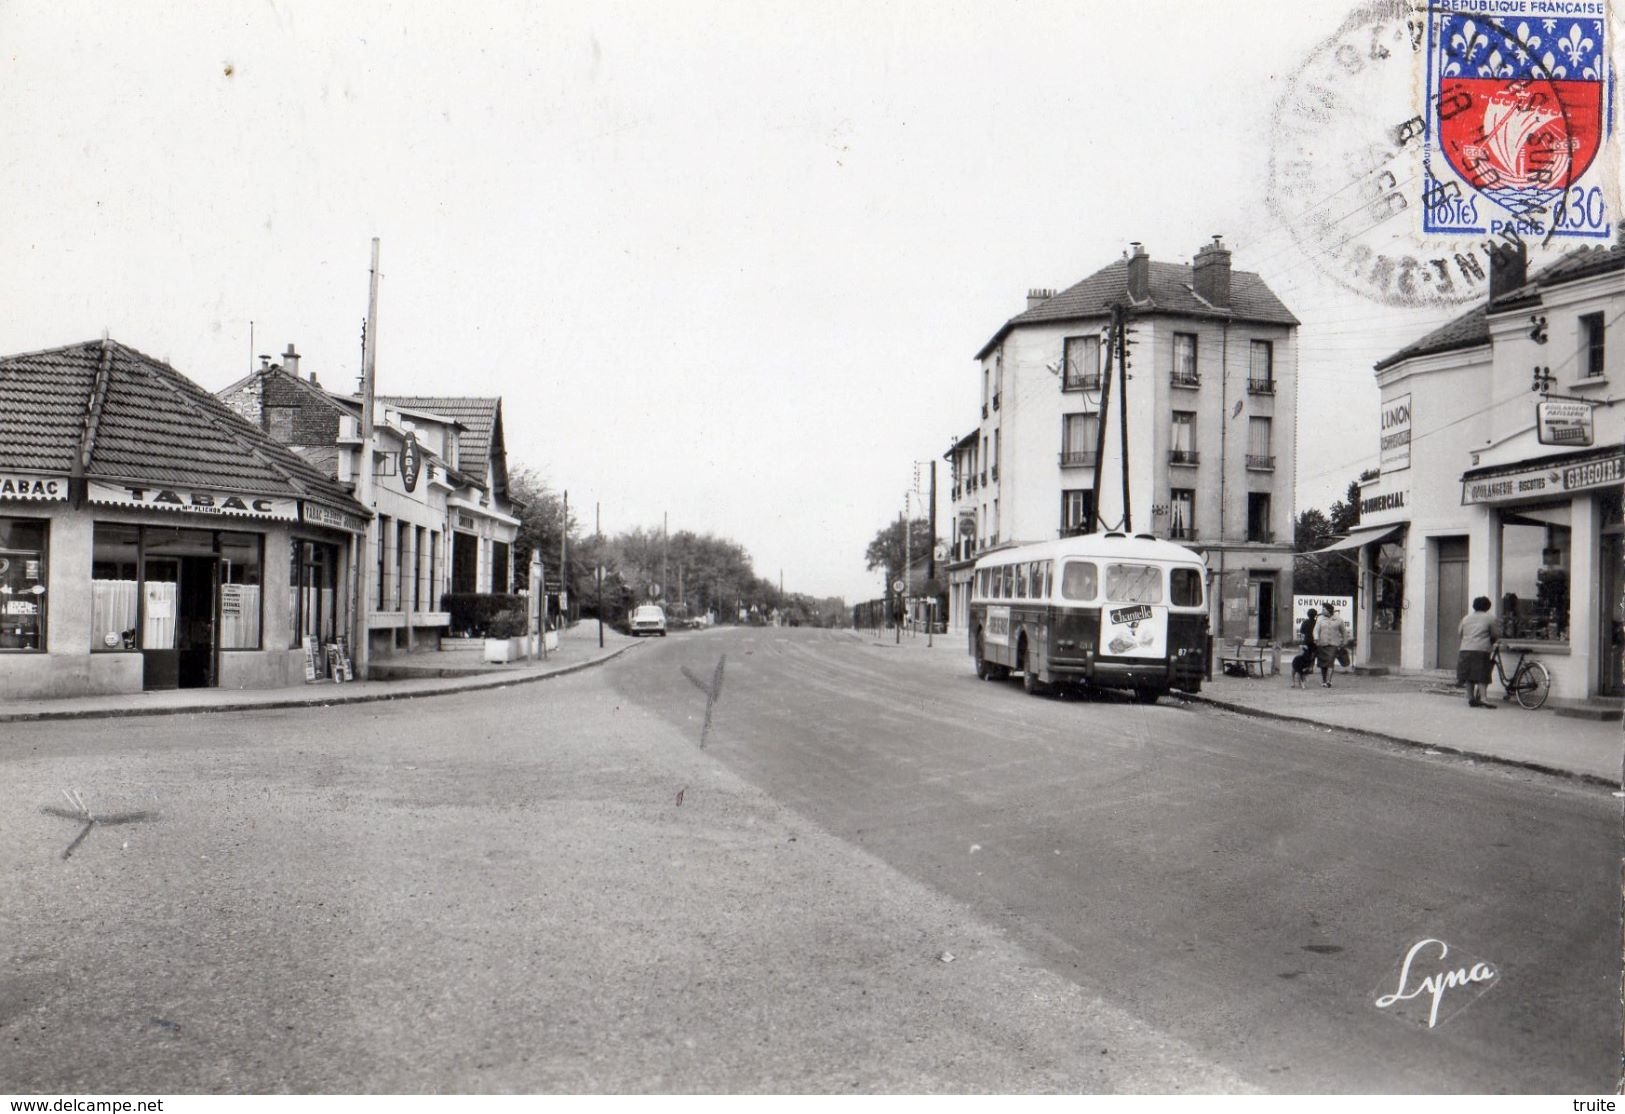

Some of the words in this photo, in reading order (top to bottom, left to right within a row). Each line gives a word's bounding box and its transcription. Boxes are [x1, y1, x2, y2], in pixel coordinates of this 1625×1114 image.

[1531, 1, 1604, 15] FRANÇAISE
[1490, 220, 1546, 237] PARIS
[405, 440, 415, 484] TABAC
[0, 478, 58, 495] ABAC
[124, 486, 273, 513] TABAC
[1111, 605, 1152, 624] Chantelle
